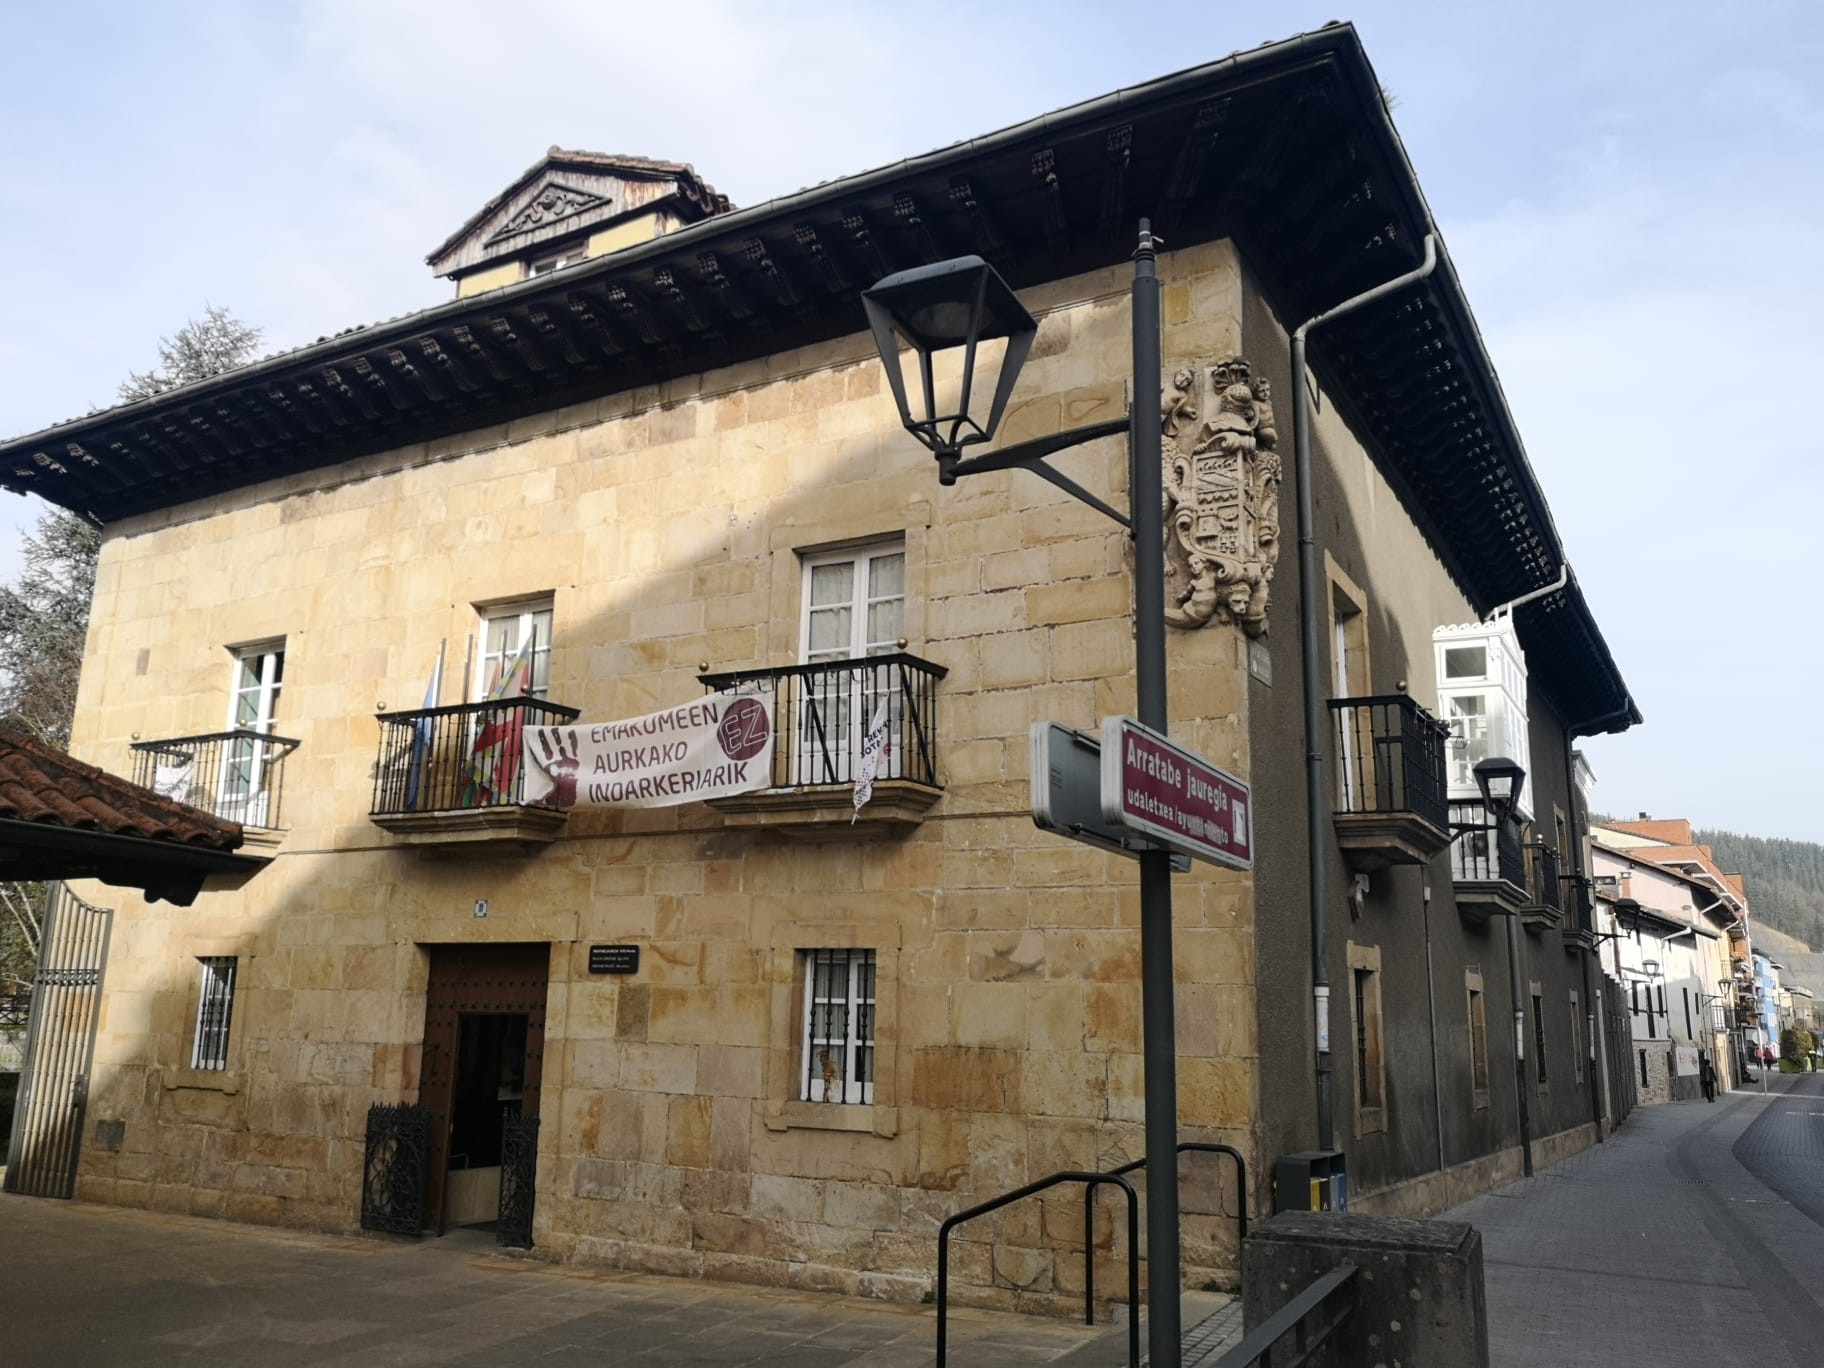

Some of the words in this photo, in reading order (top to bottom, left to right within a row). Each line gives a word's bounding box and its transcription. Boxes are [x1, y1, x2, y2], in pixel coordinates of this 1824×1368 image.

[591, 703, 719, 743] EMAKUMEEN
[720, 704, 768, 755] EZ
[593, 741, 688, 774] AURKAKO
[1127, 738, 1182, 788] Arratabe
[1187, 767, 1228, 812] jauregia
